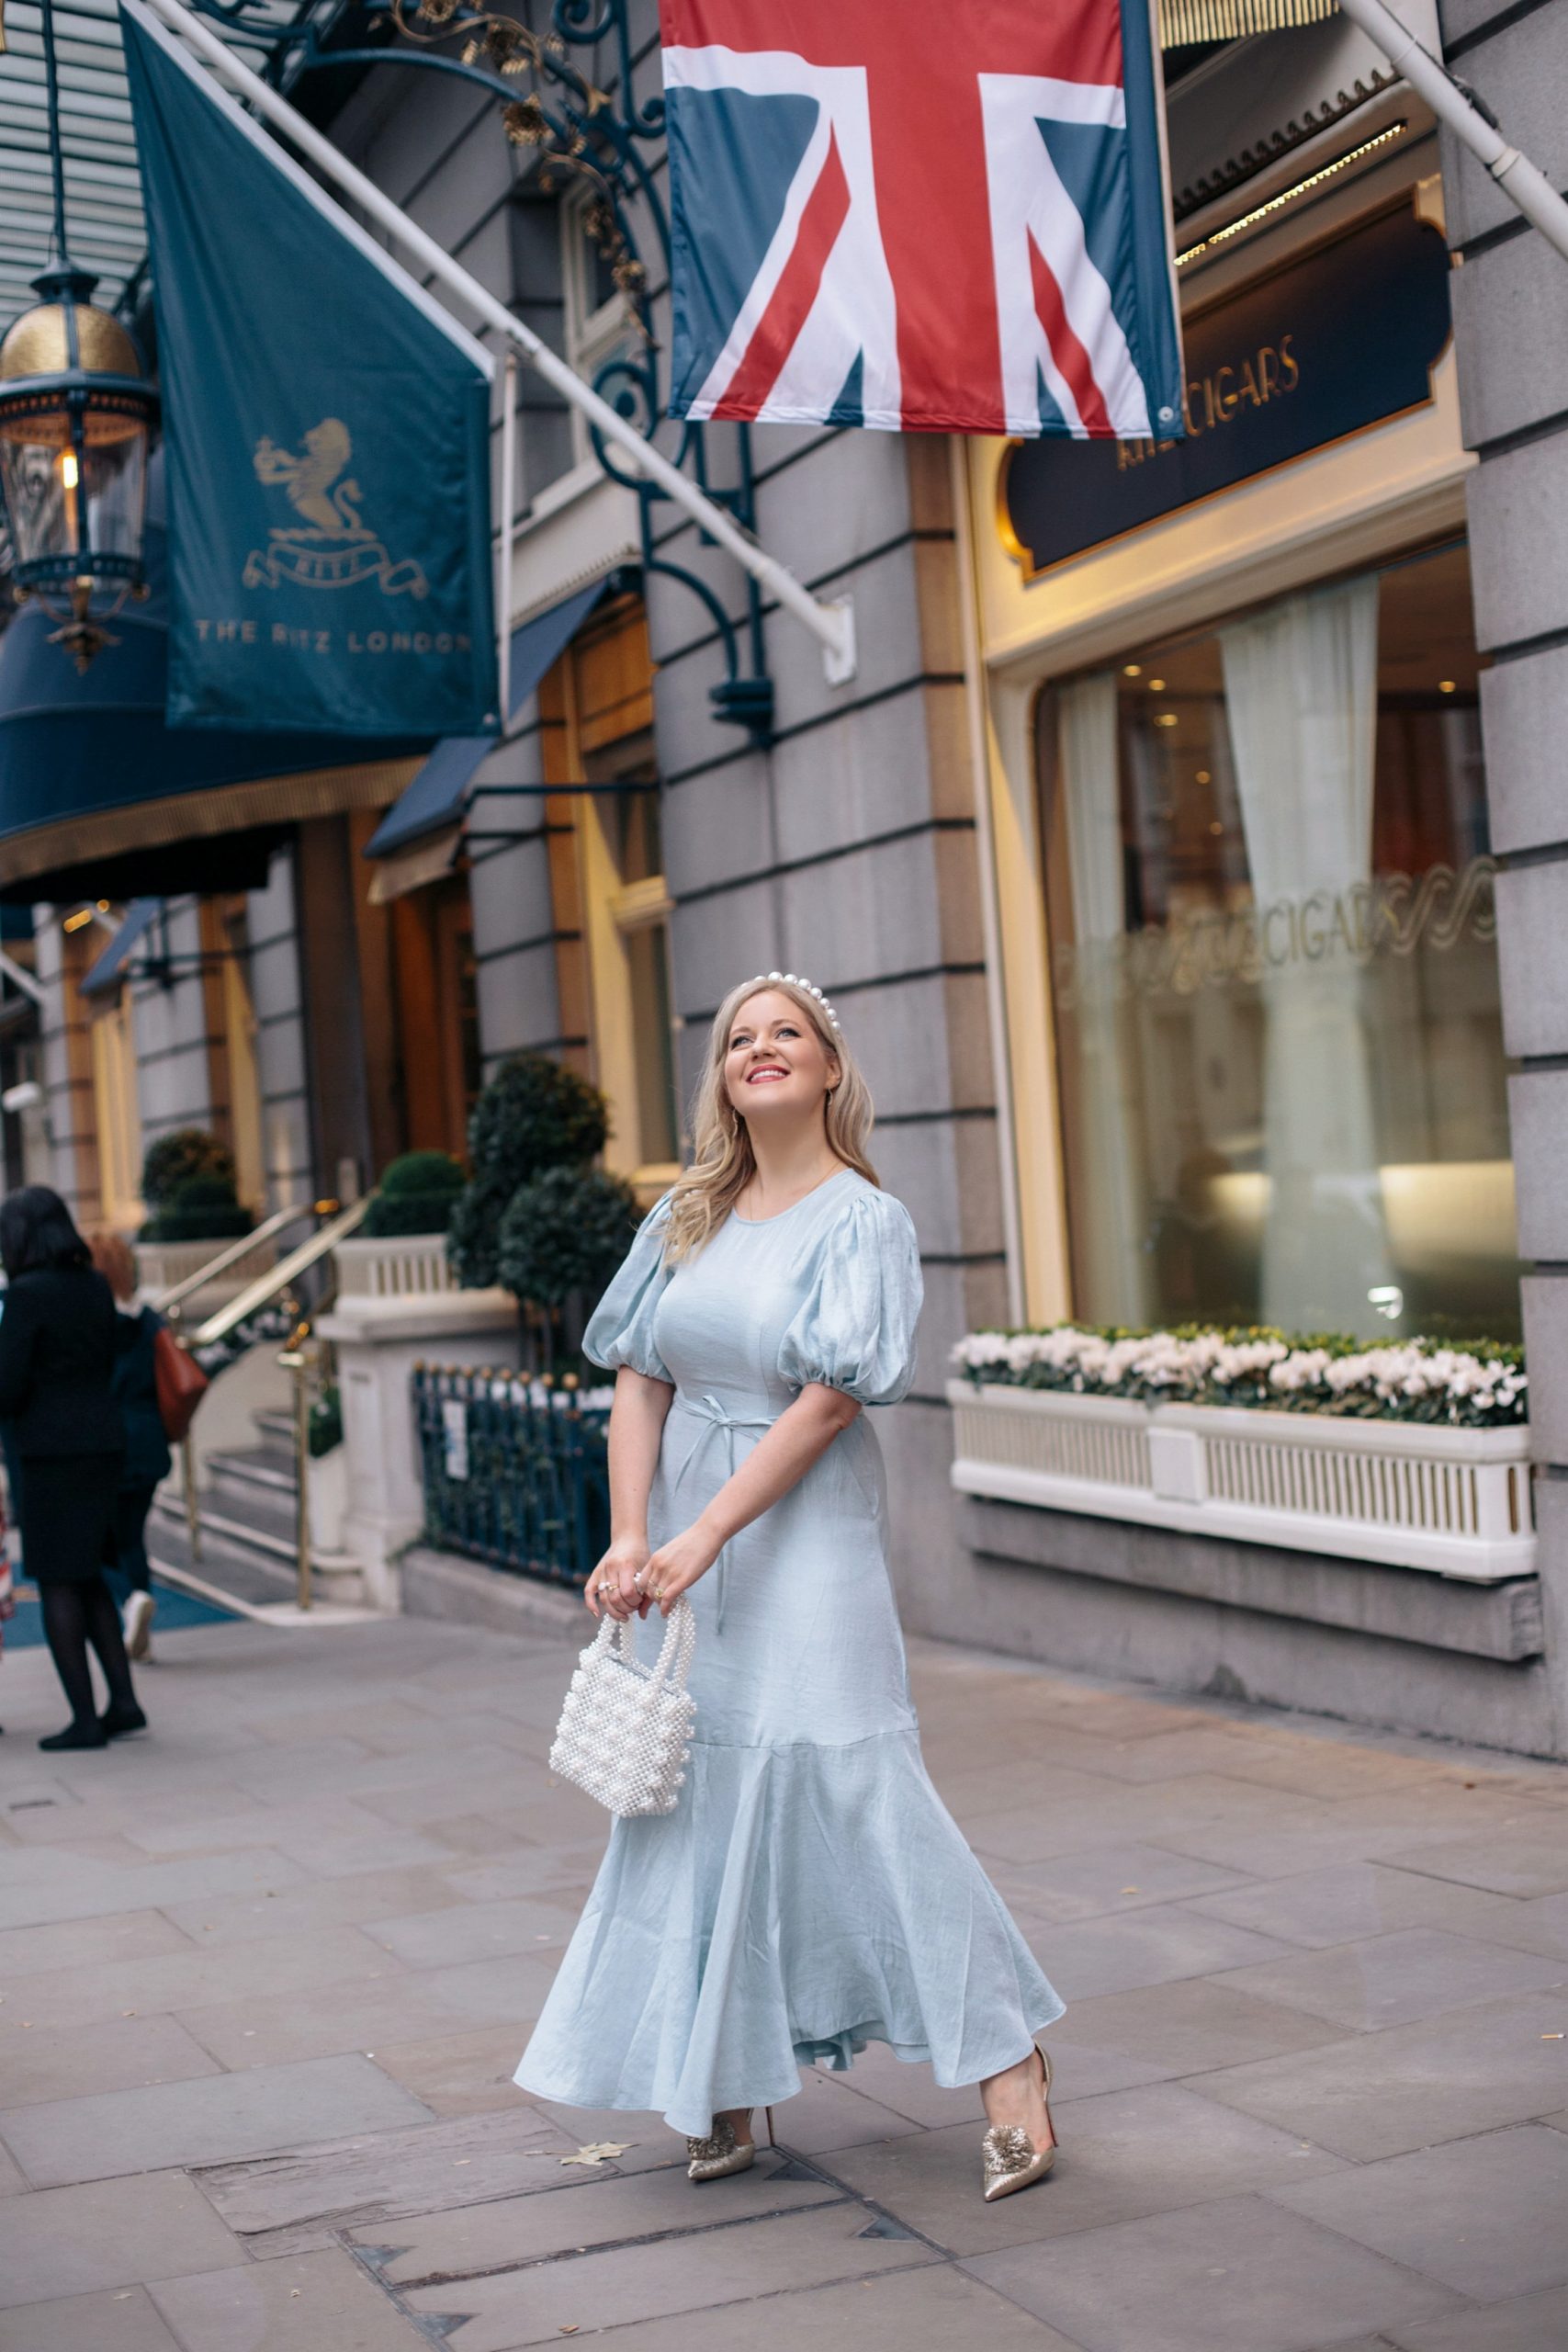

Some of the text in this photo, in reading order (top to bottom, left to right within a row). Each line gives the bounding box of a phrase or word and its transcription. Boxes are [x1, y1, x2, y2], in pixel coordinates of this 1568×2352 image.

[1184, 334, 1299, 436] CIGARS
[195, 619, 471, 654] THE RITZ LONDON
